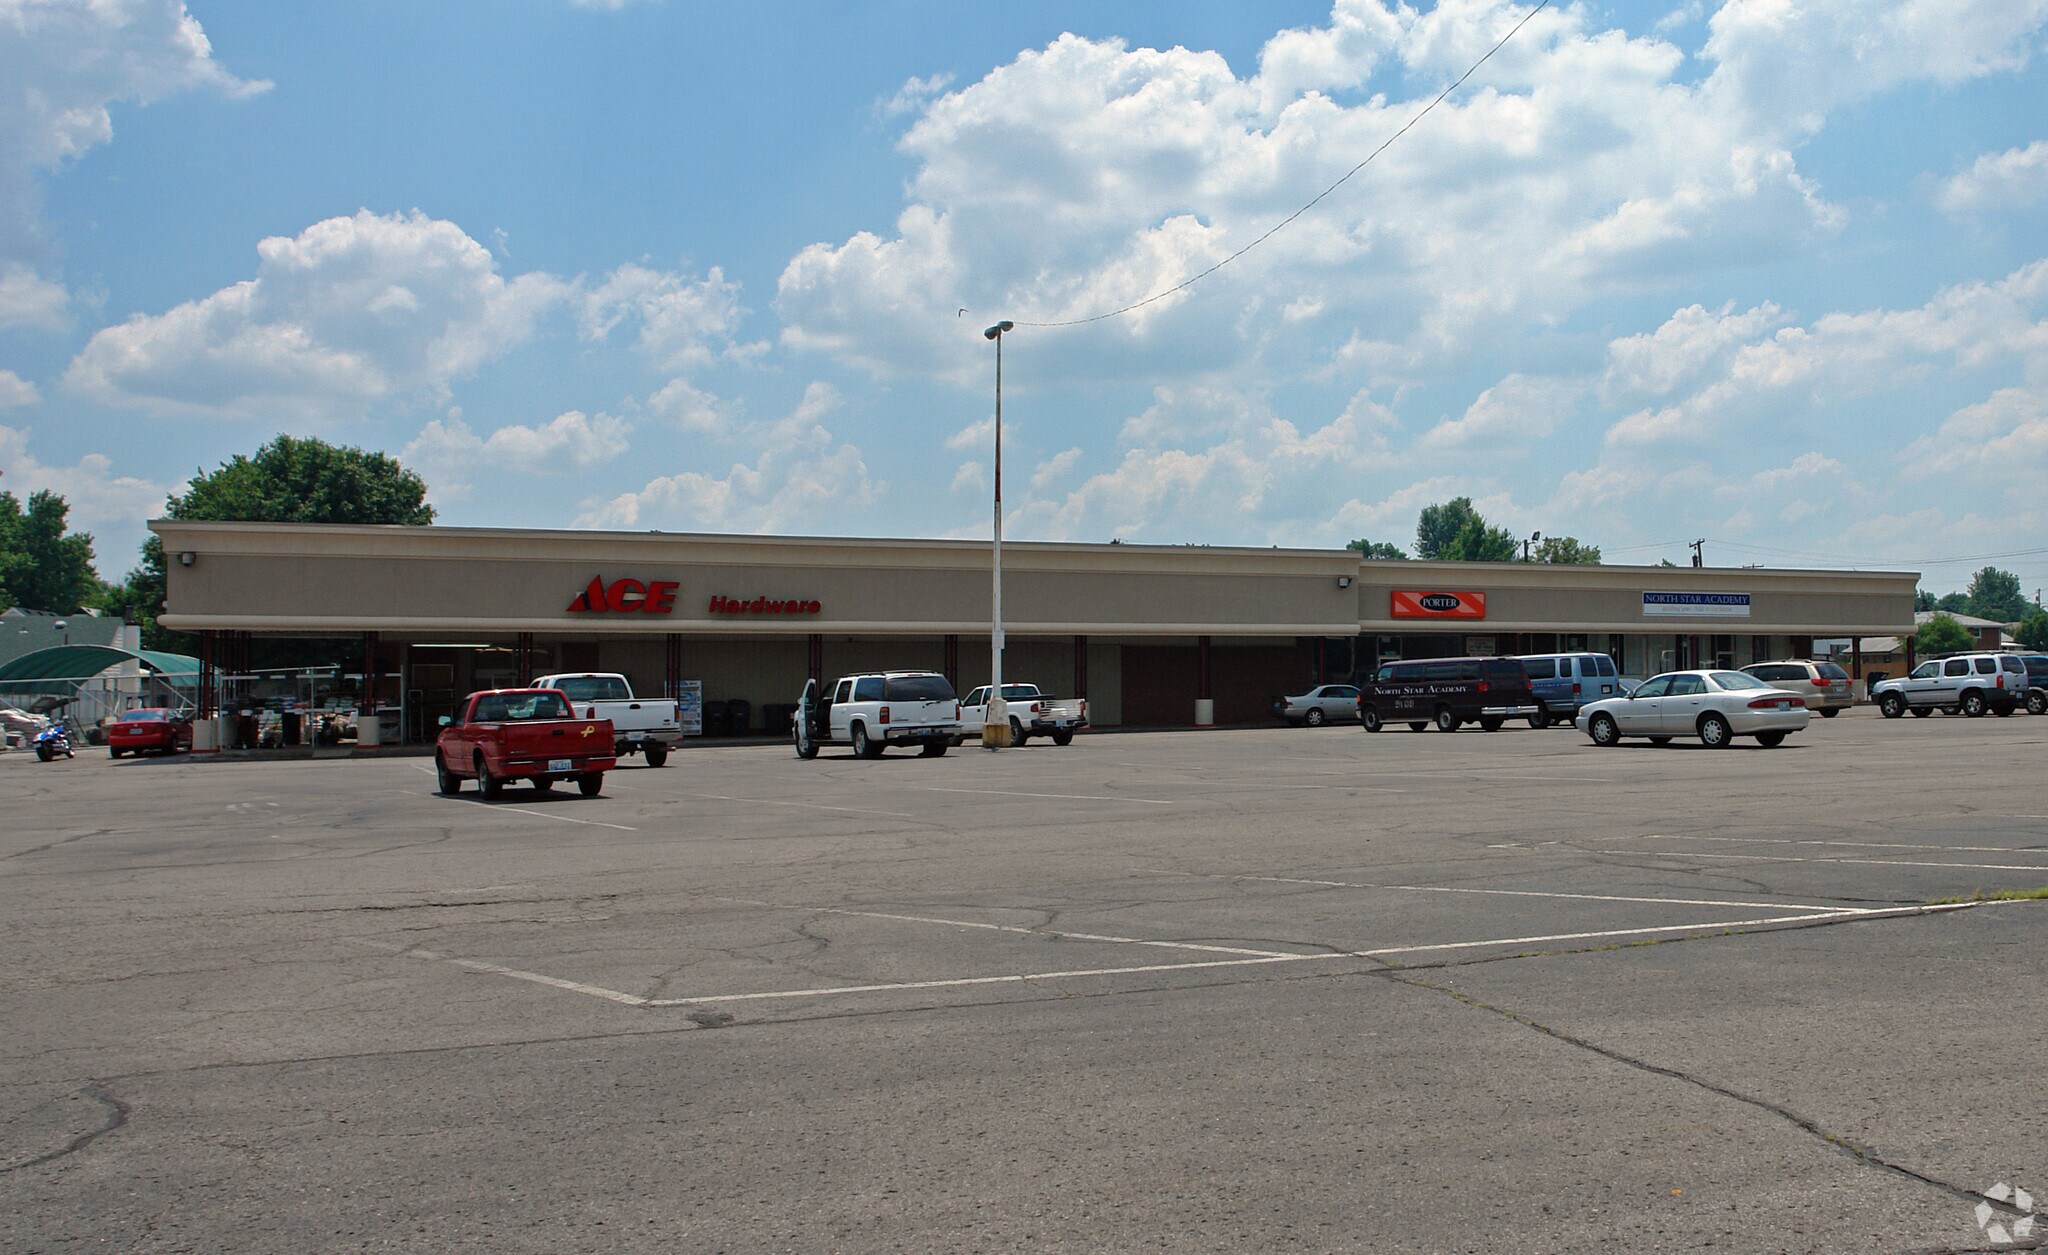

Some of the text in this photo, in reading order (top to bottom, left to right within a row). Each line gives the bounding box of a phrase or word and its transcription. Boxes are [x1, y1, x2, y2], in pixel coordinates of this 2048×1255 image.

[566, 574, 822, 613] ACE Hardware
[1423, 598, 1457, 608] PORTER
[1645, 594, 1749, 605] NORTH STAR ACADEMY
